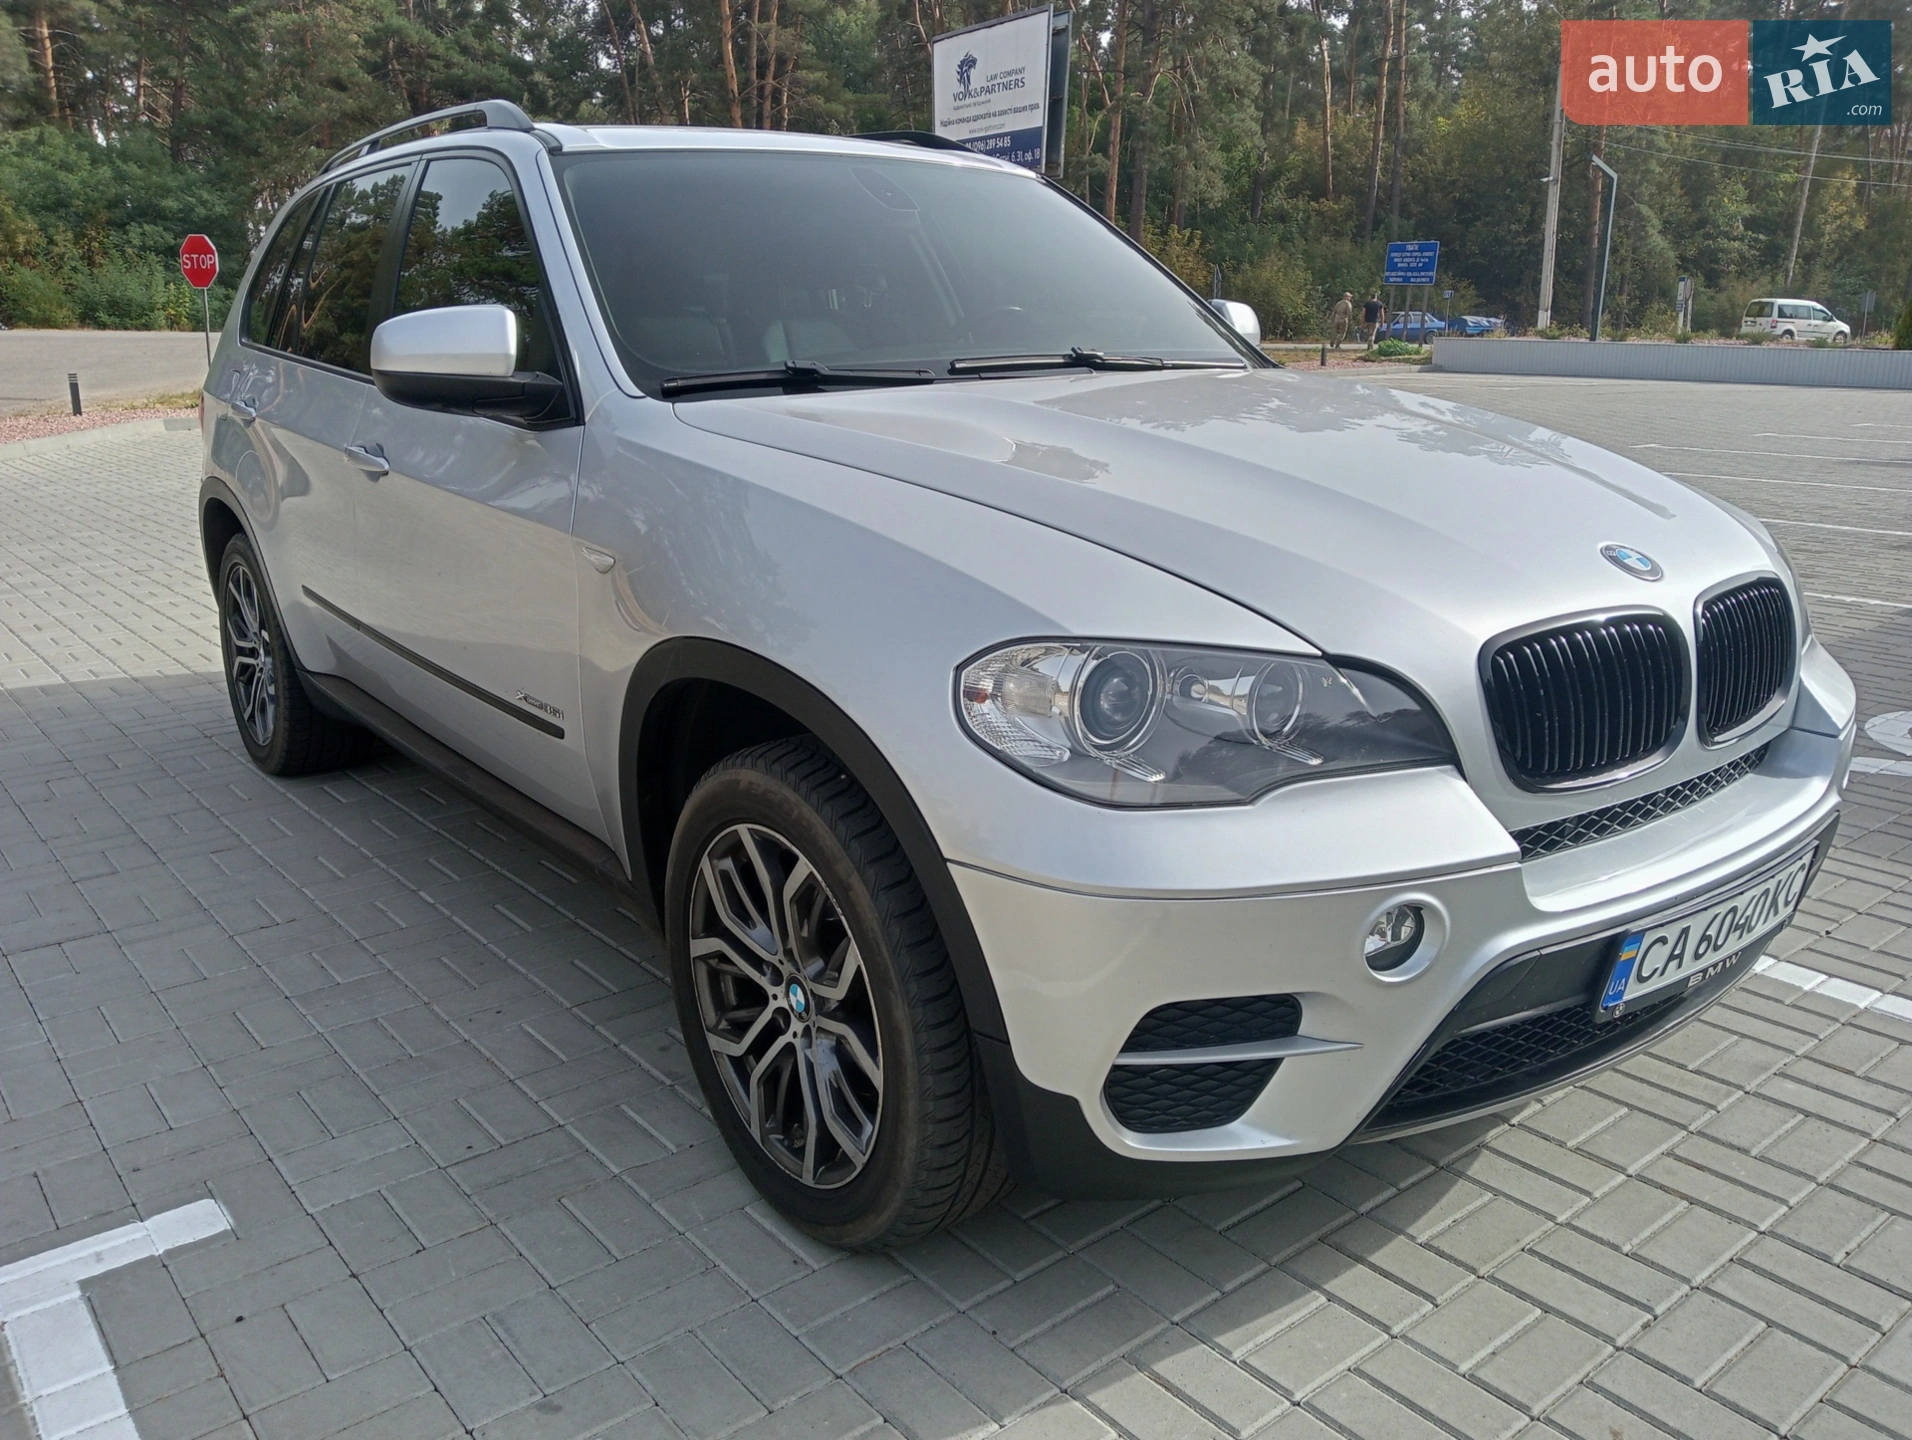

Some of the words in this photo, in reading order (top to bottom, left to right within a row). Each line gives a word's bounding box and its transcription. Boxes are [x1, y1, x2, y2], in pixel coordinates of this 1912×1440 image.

[986, 72, 999, 83] LAW
[999, 66, 1027, 80] COMPANY
[986, 138, 996, 150] 289
[996, 137, 1003, 148] 54
[1004, 136, 1011, 147] 85
[183, 254, 214, 269] STOP
[1687, 951, 1742, 988] BMW
[1608, 977, 1626, 995] UA
